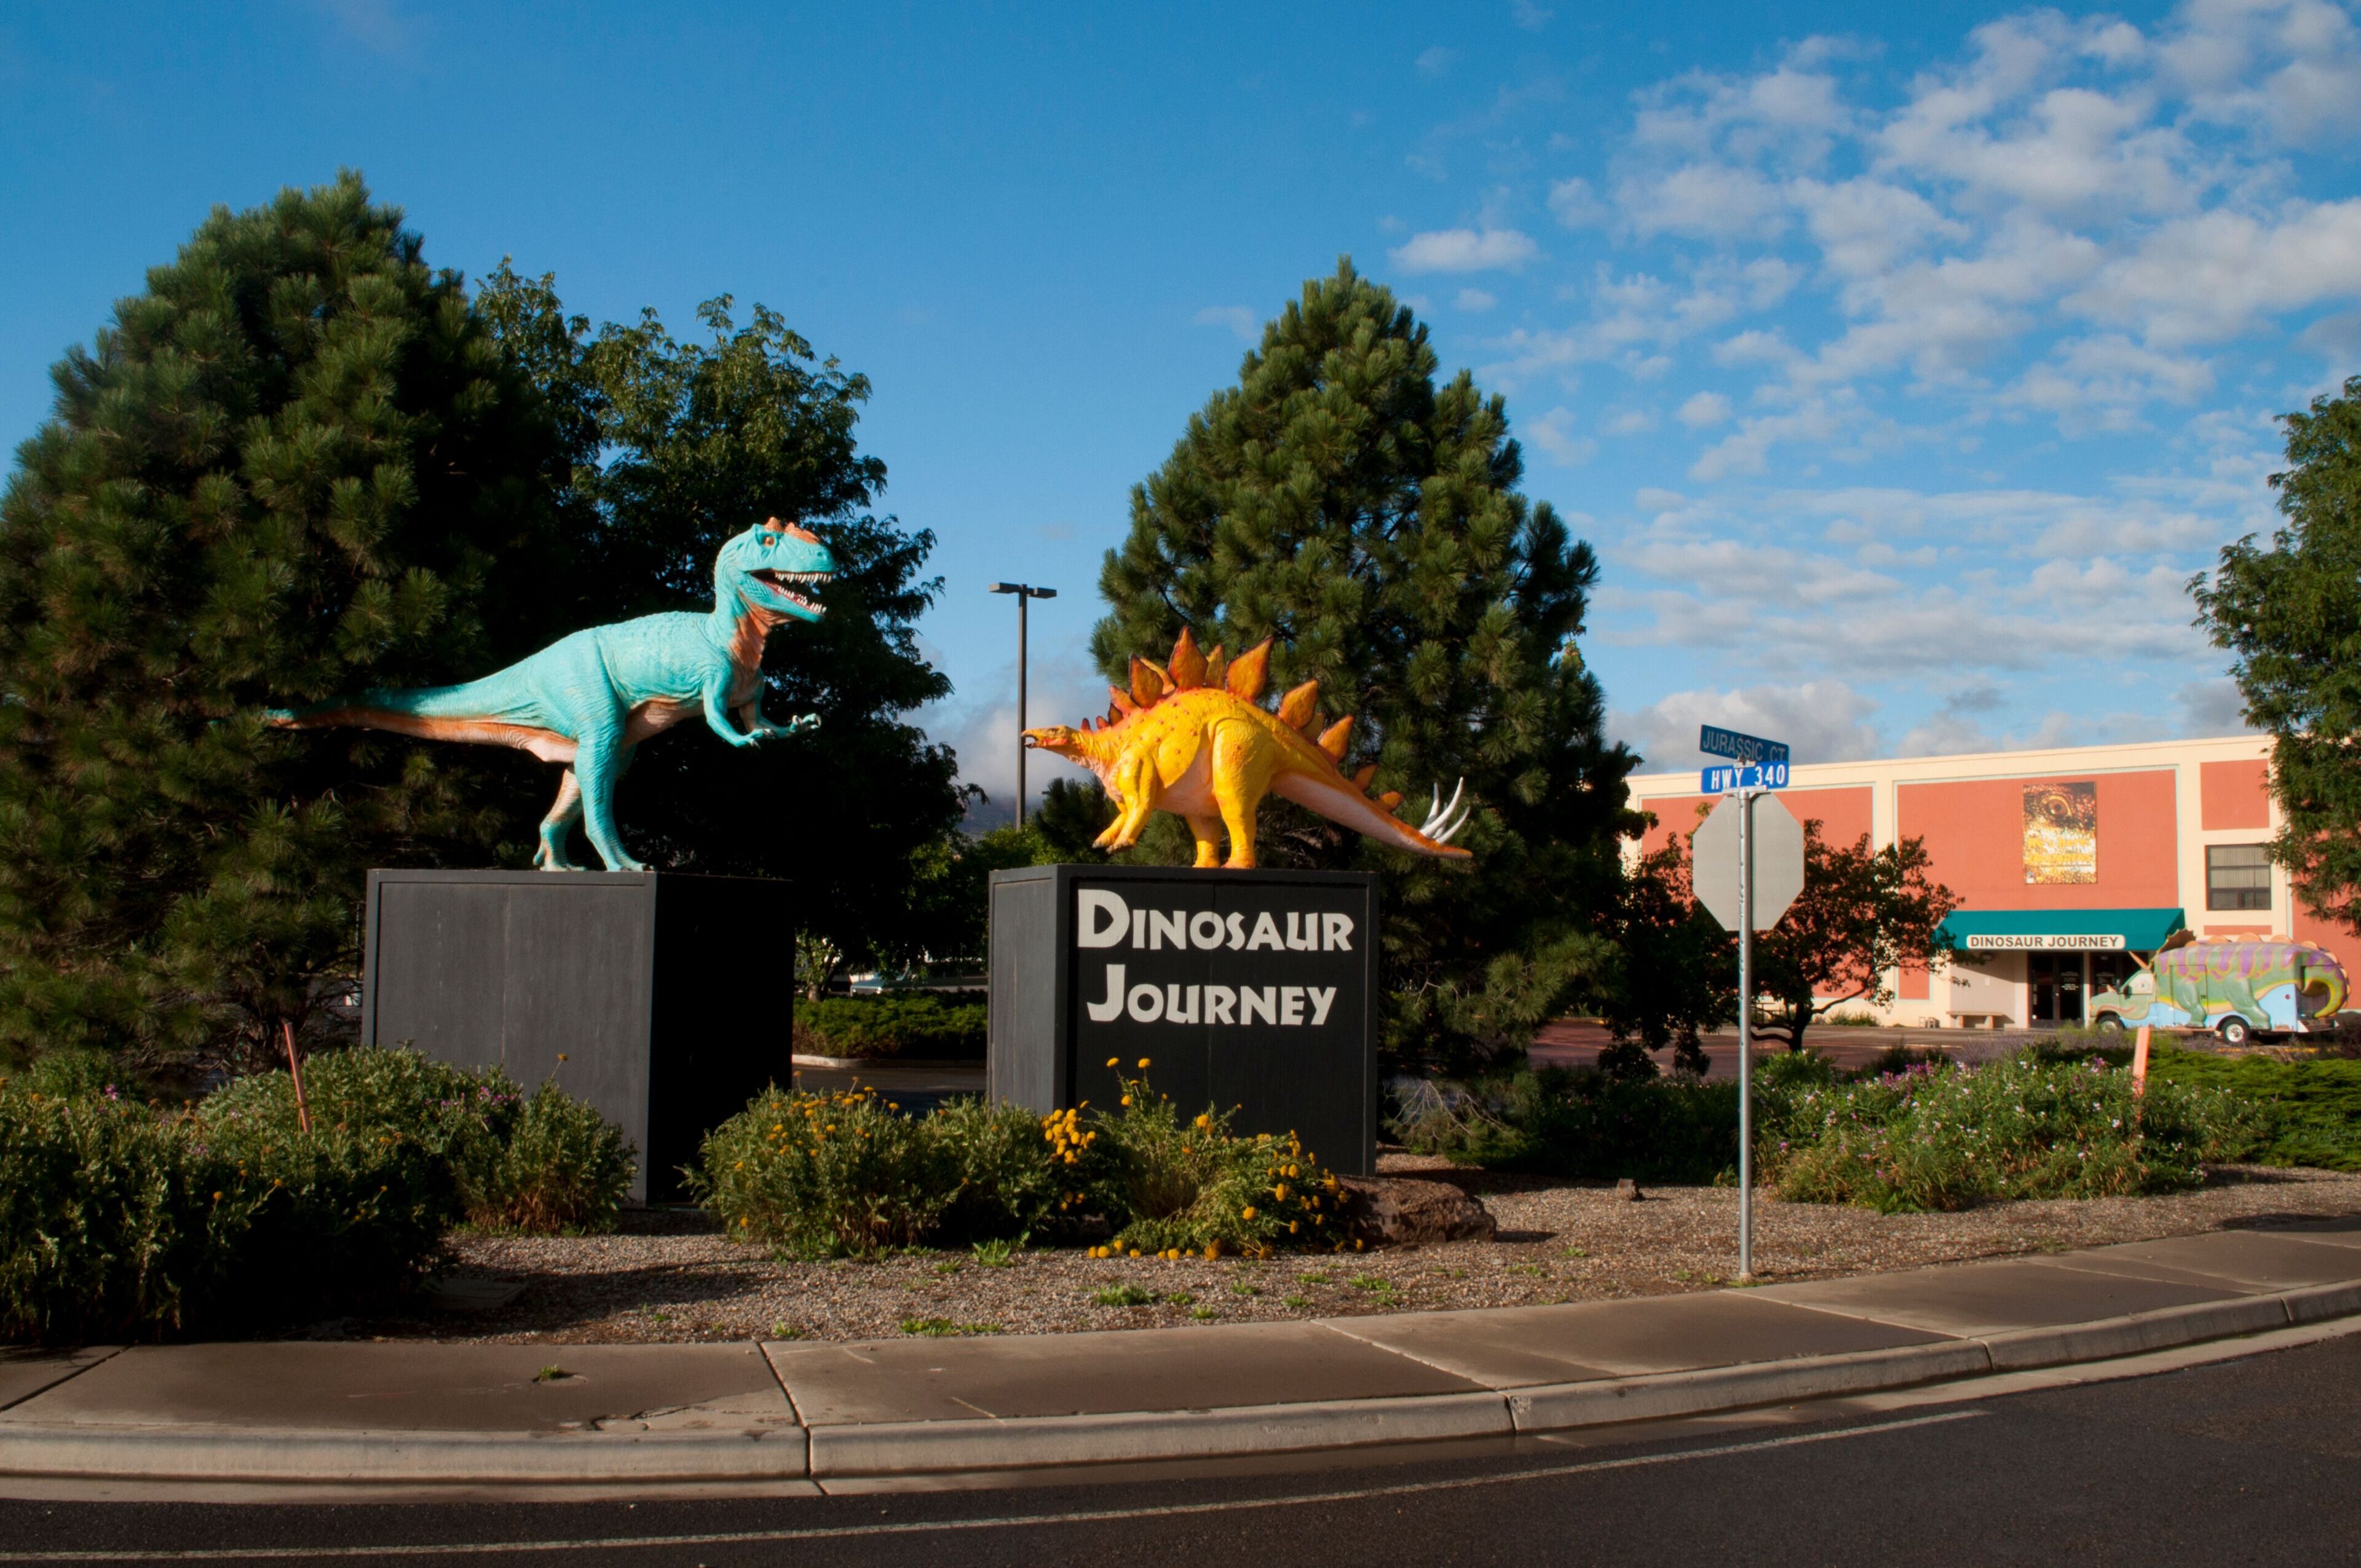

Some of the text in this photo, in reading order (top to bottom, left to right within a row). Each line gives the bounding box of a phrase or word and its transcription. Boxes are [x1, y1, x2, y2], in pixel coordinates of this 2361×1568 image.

[1703, 730, 1786, 762] JURASSIC CT
[1711, 764, 1786, 790] HWY 340
[1077, 889, 1353, 950] DINOSAUR
[1971, 936, 2118, 947] DINOSAUR JOURNEY
[1086, 964, 1337, 1025] JOURNEY
